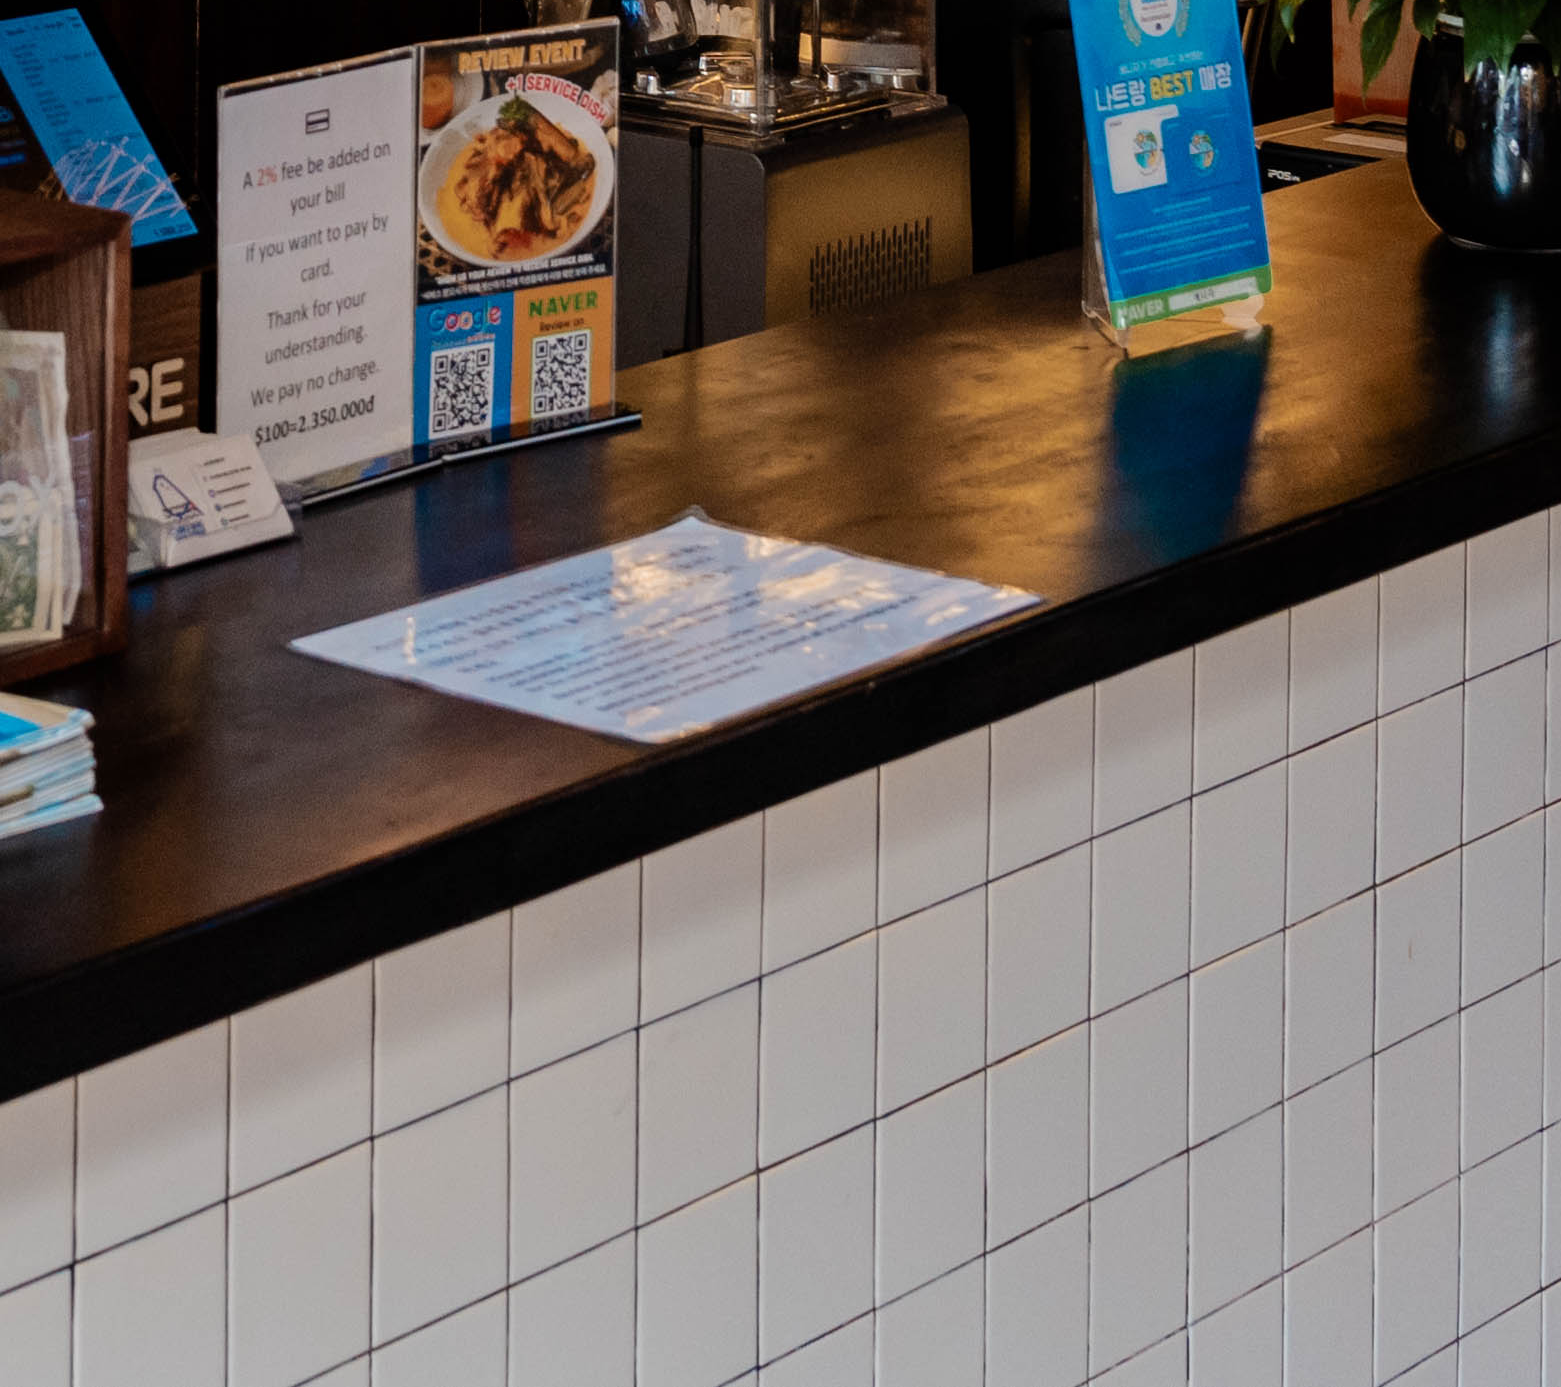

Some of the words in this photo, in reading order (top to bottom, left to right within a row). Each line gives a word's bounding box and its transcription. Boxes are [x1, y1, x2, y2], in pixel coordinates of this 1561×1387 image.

[458, 46, 526, 75] REVIEW
[529, 38, 586, 66] EVENT
[506, 76, 524, 91] +1
[526, 76, 581, 104] SERVICE
[579, 90, 609, 123] DISH
[1095, 79, 1147, 112] 나트랑
[1149, 69, 1194, 101] BEST
[1198, 61, 1232, 91] 매장
[242, 172, 253, 190] A
[256, 164, 278, 187] 2%
[281, 161, 304, 182] fee
[307, 156, 325, 175] be
[327, 142, 370, 170] added
[373, 142, 391, 159] on
[289, 192, 321, 217] your
[325, 181, 346, 204] bill
[245, 241, 257, 264] If
[258, 241, 285, 264] you
[288, 229, 323, 252] want
[326, 226, 341, 243] to
[344, 220, 369, 242] pay
[372, 212, 389, 233] by
[300, 257, 335, 283] card.
[266, 303, 310, 330] Thank
[312, 297, 333, 318] for
[335, 290, 367, 316] your
[430, 299, 502, 336] Google
[528, 290, 598, 318] NAVER
[1116, 298, 1164, 325] NAVER
[264, 324, 369, 365] understanding.
[250, 386, 275, 409] We
[278, 381, 304, 404] pay
[306, 375, 325, 393] no
[328, 359, 381, 387] change.
